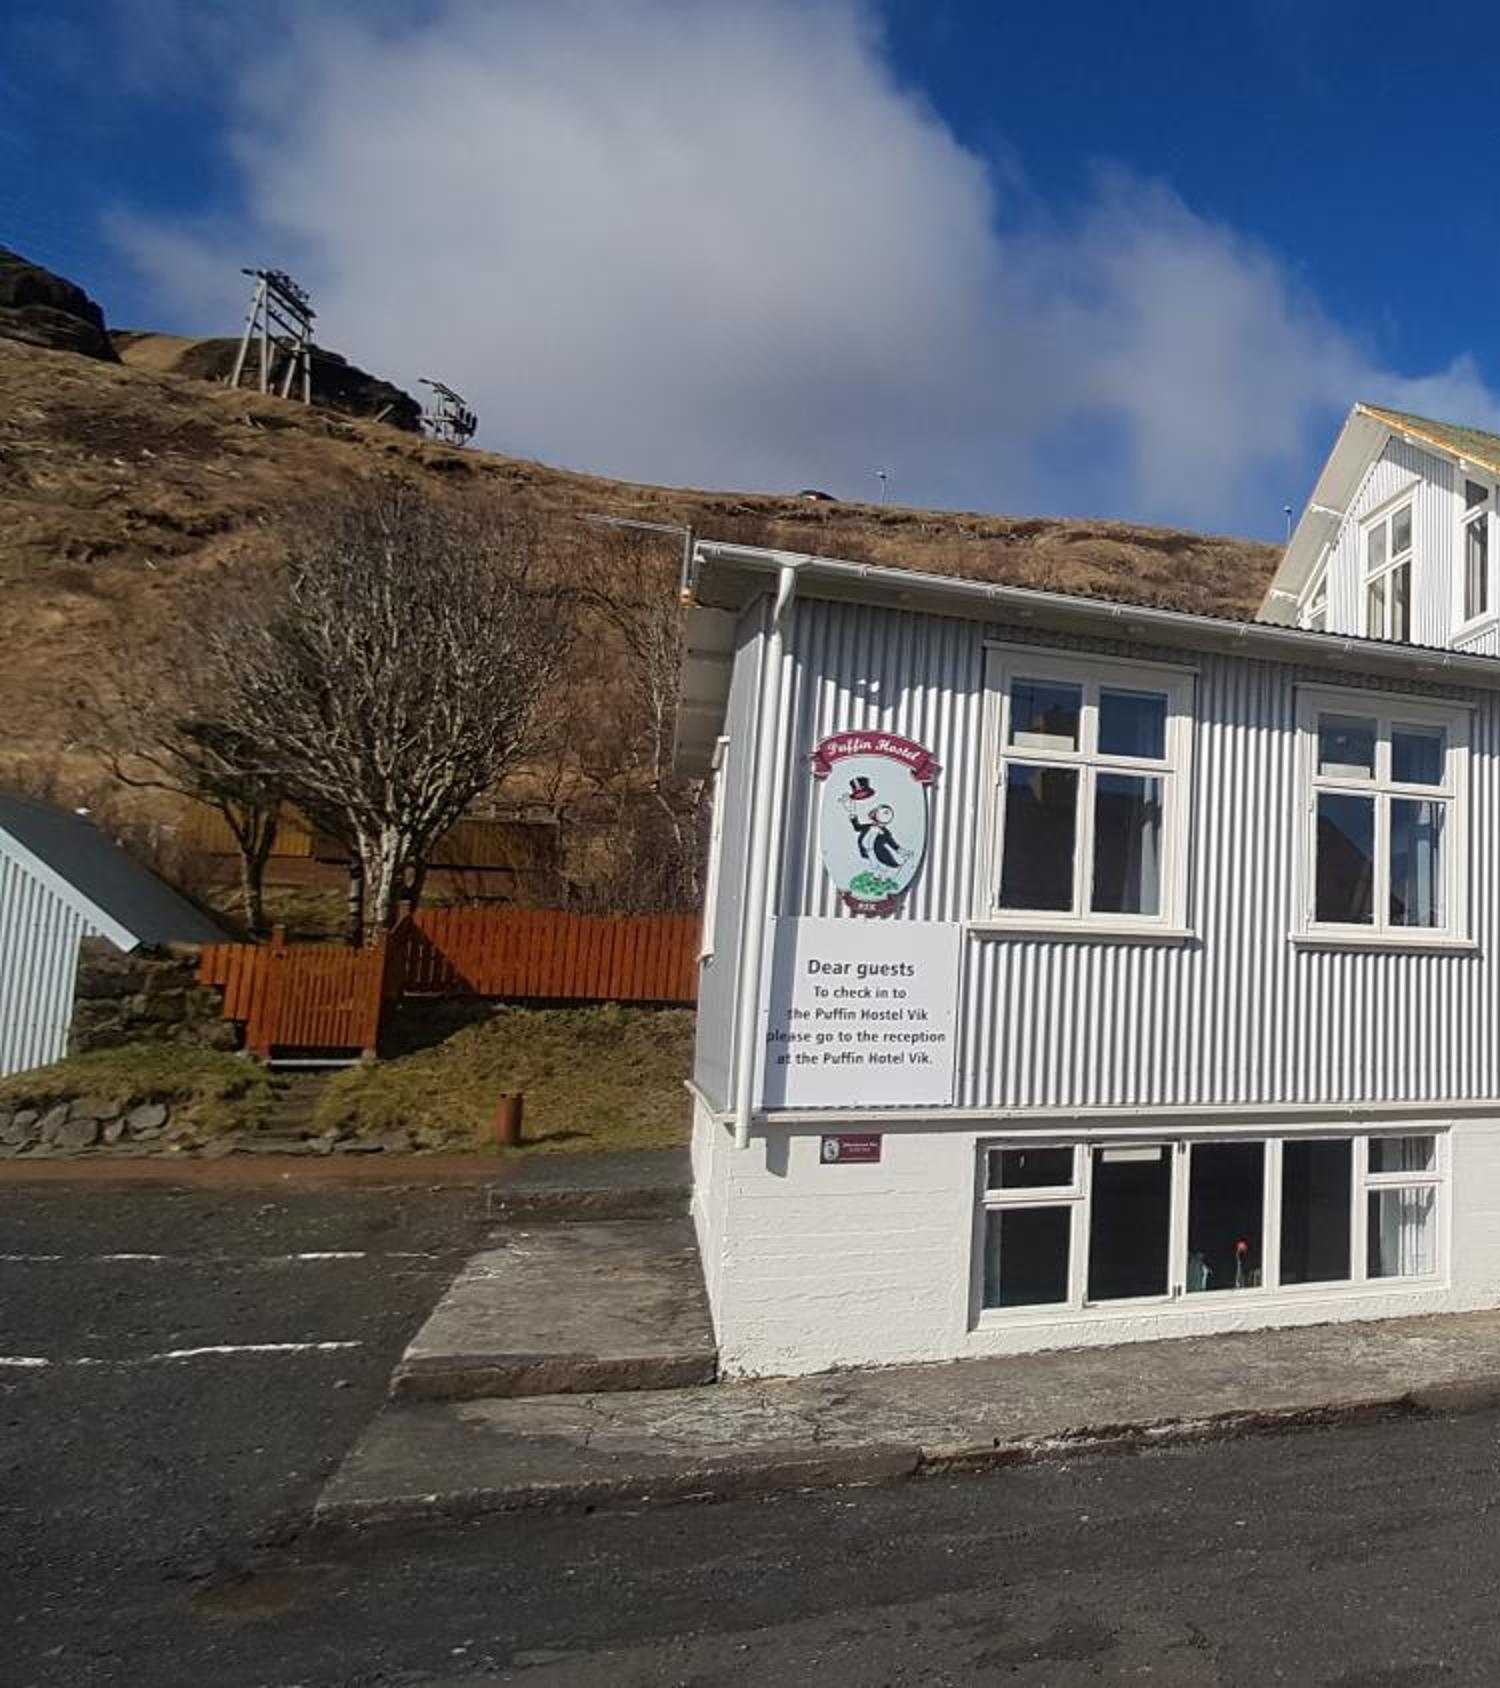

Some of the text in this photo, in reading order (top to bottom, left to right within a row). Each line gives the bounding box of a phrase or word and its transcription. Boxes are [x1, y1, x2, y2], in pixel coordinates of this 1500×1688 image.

[827, 738, 921, 760] Puffin Hostel
[807, 959, 915, 979] Dear guests
[814, 986, 907, 999] To check in to
[787, 1007, 929, 1021] the Puffin Hostel Vik
[767, 1029, 946, 1045] please go to the reception
[777, 1052, 933, 1065] at the Puffin Hotel Vik.
